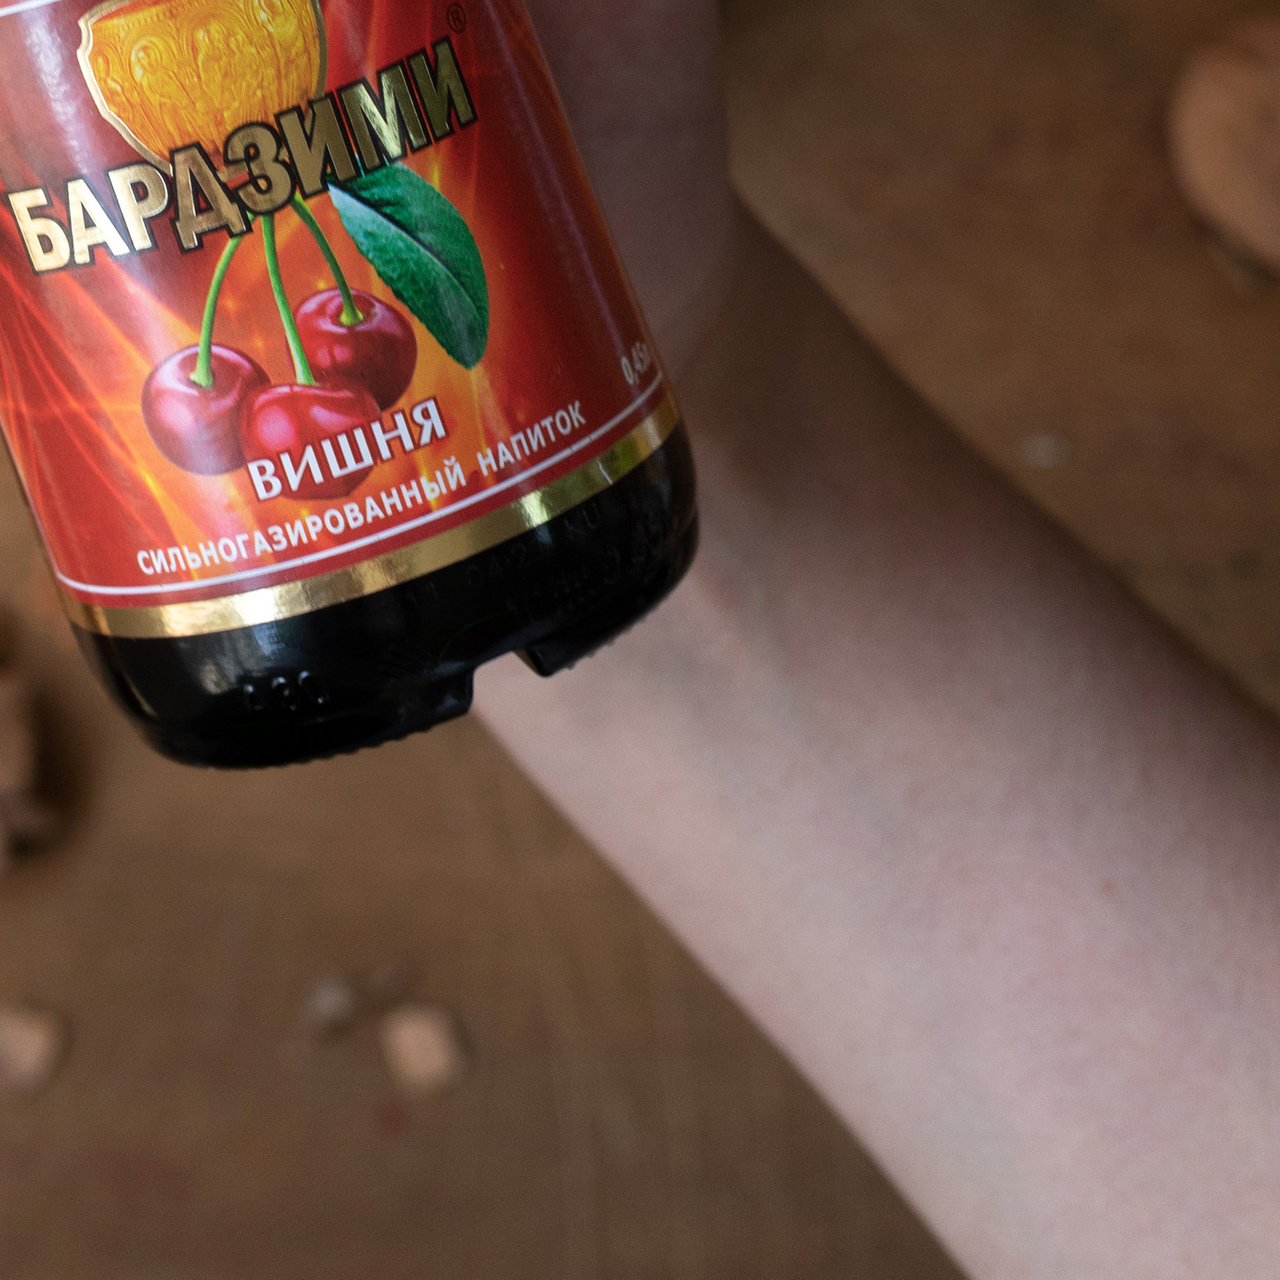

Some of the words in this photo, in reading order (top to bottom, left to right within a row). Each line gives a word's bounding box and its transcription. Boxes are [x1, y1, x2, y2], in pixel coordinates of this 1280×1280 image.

[6, 36, 478, 274] БАРДЗИМИ
[136, 459, 468, 576] СИЛЬНОГАЗИРОВАННЫЙ
[476, 400, 588, 478] НАПИТОК
[246, 396, 448, 502] ВИШНЯ
